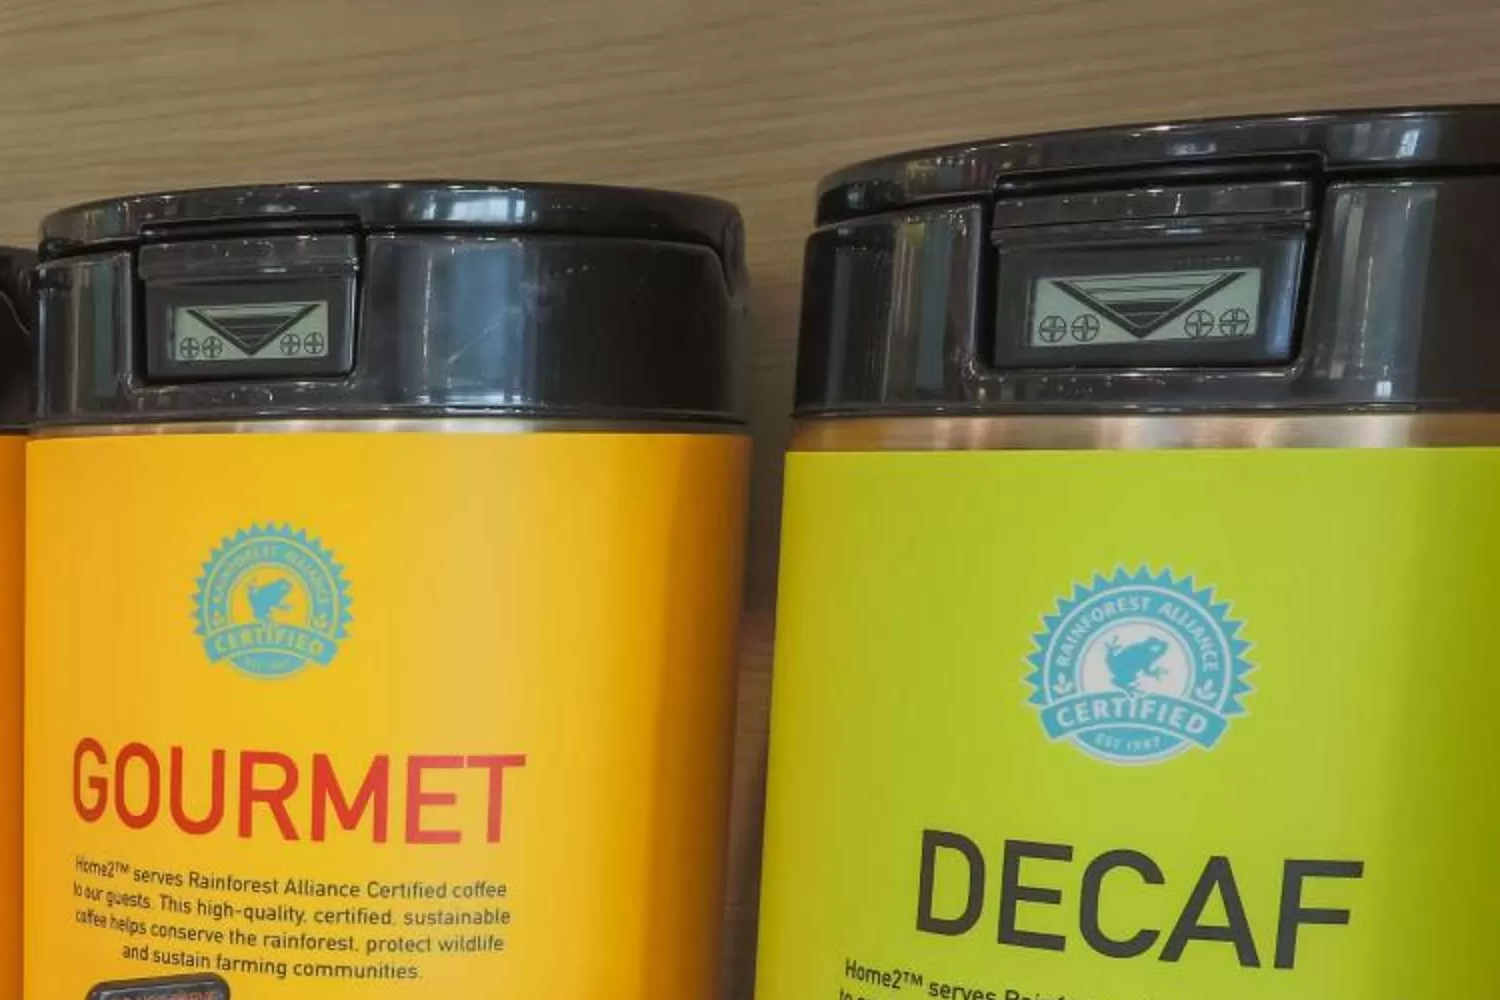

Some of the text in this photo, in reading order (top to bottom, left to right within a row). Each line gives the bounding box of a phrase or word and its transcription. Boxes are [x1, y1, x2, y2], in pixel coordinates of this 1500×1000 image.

[1056, 596, 1219, 672] RAINFOREST ALLIANCE
[1056, 697, 1208, 735] CERTIFIED
[72, 737, 526, 844] GOURMET
[133, 868, 183, 888] serves
[189, 871, 278, 894] Rainforest
[284, 879, 361, 898] Alliance
[367, 880, 447, 899] Certified
[452, 881, 507, 899] coffee
[916, 829, 1365, 970] DECAF
[84, 886, 103, 901] our
[160, 893, 191, 914] This
[403, 907, 511, 925] sustainable
[75, 908, 107, 929] coffee
[110, 916, 147, 936] helps
[151, 921, 224, 944] conserve
[229, 928, 257, 947] the
[365, 935, 431, 956] protect
[437, 934, 505, 952] wildlife
[122, 944, 422, 981] and sustain farming communities.
